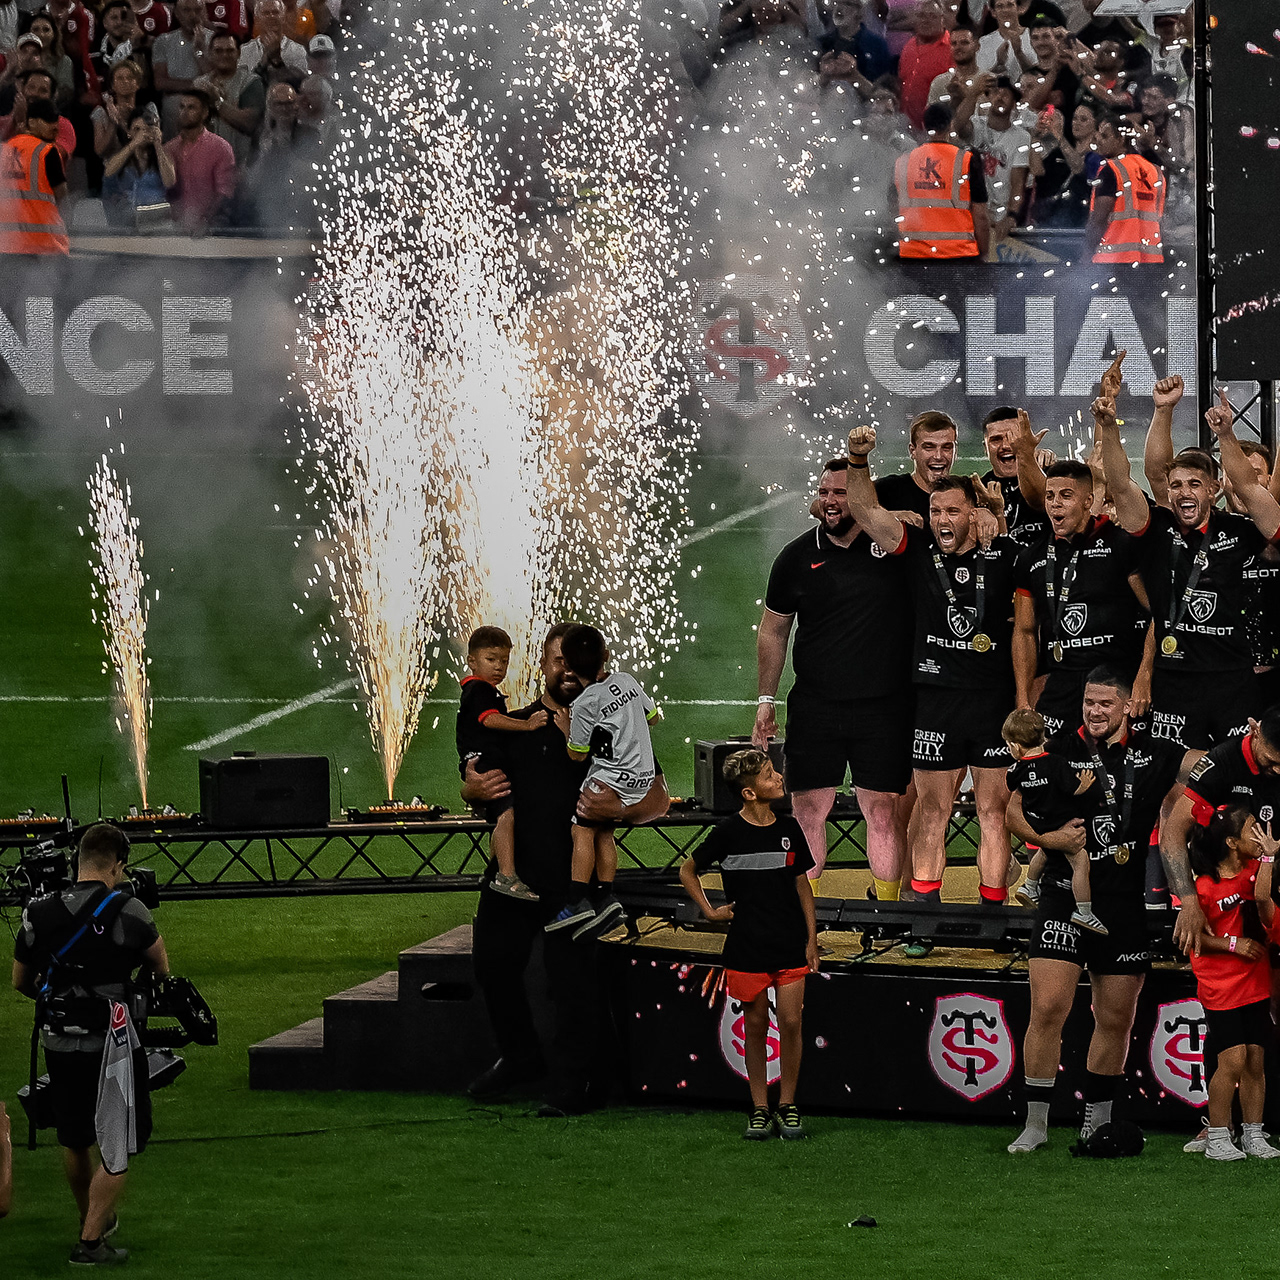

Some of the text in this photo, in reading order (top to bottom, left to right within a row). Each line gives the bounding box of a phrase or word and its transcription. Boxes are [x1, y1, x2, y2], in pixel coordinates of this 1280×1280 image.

[1210, 537, 1240, 550] REMPART
[926, 634, 998, 651] PEUGET
[1153, 712, 1186, 725] GREEN
[914, 728, 946, 742] GREEN
[1151, 724, 1184, 739] CITY
[912, 739, 946, 756] CITY
[1044, 920, 1081, 937] GREEN
[1041, 930, 1078, 948] CITY
